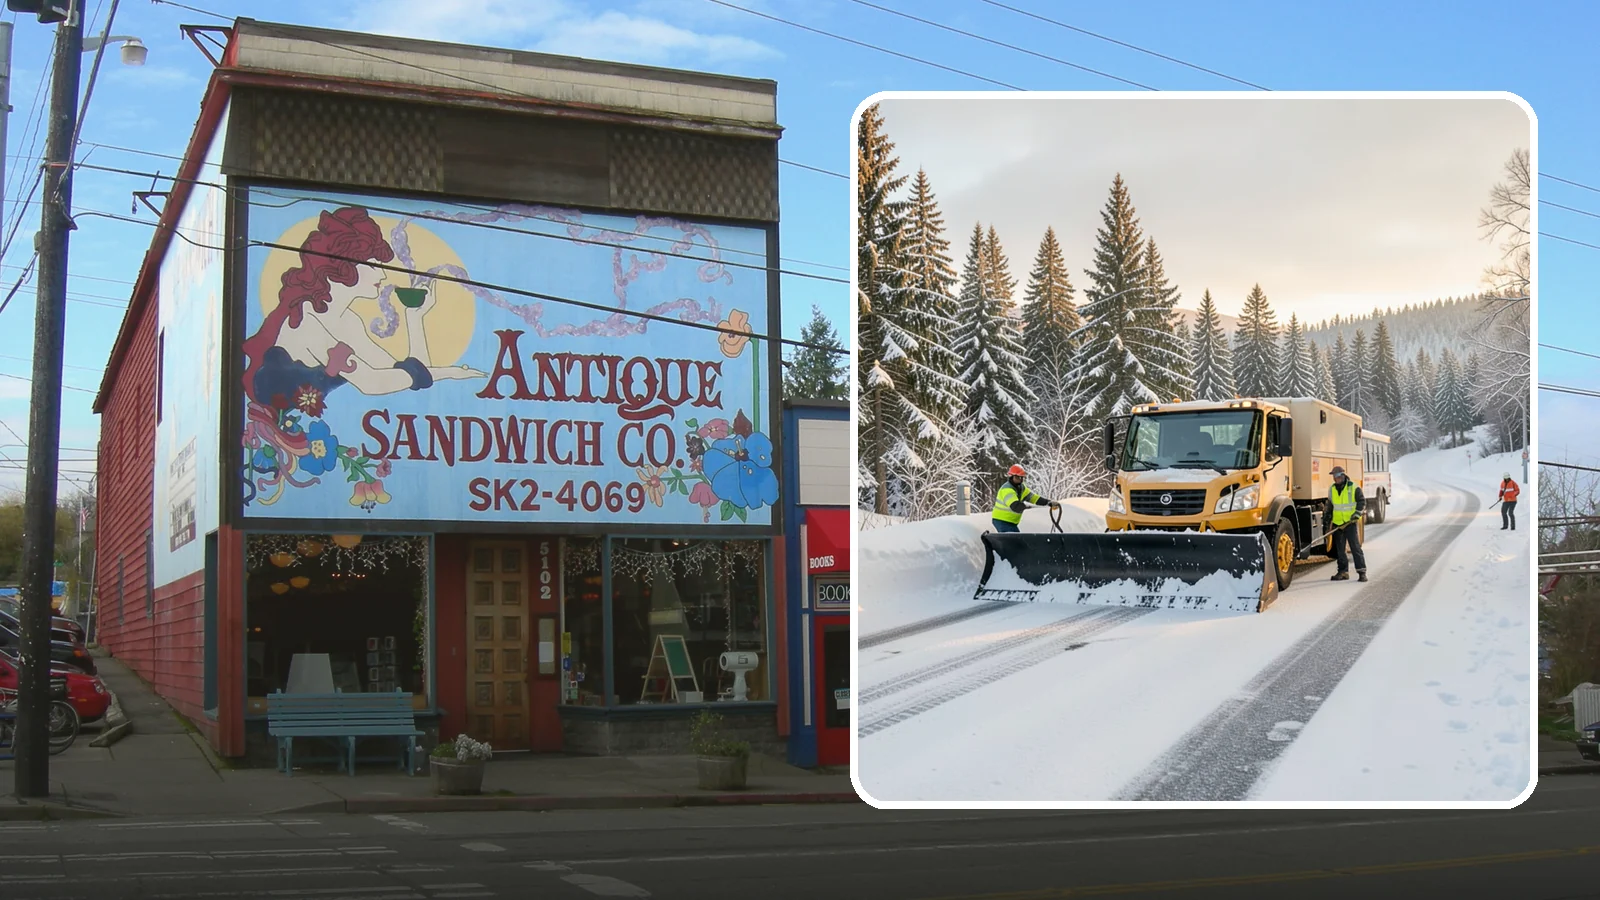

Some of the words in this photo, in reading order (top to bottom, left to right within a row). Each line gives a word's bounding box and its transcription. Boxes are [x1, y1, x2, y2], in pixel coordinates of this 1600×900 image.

[476, 329, 723, 421] ANTIQUE
[361, 408, 605, 467] SANDWICH
[617, 421, 684, 468] CO.
[468, 478, 645, 513] SK2-4069
[540, 541, 551, 600] 5102
[809, 555, 835, 569] BOOKS
